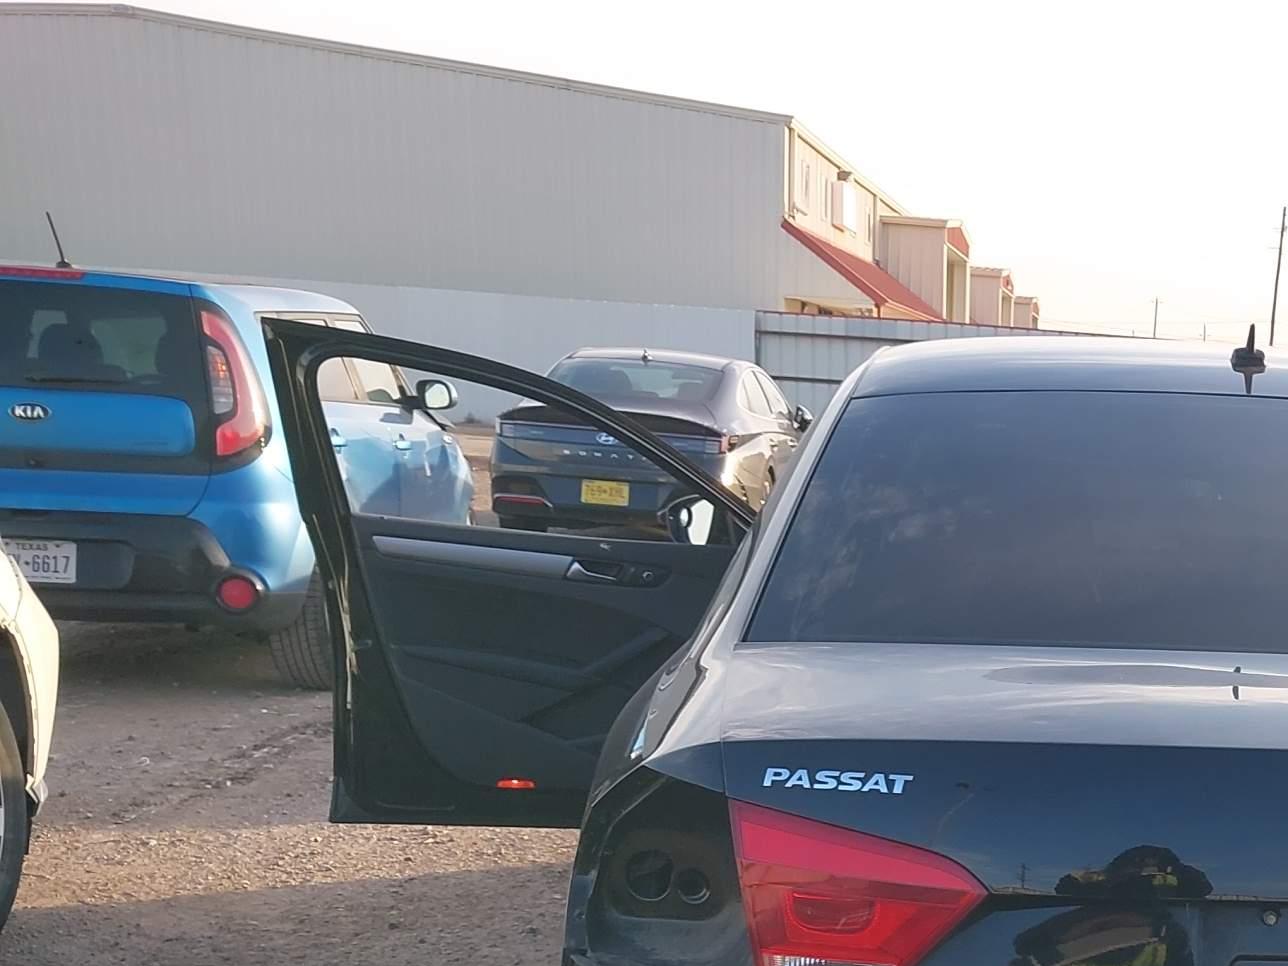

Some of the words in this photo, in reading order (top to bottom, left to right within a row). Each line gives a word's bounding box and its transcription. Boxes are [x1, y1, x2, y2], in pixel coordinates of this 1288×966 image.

[14, 404, 46, 418] KIA
[15, 542, 48, 551] TEXAS
[762, 767, 914, 794] PASSAT
